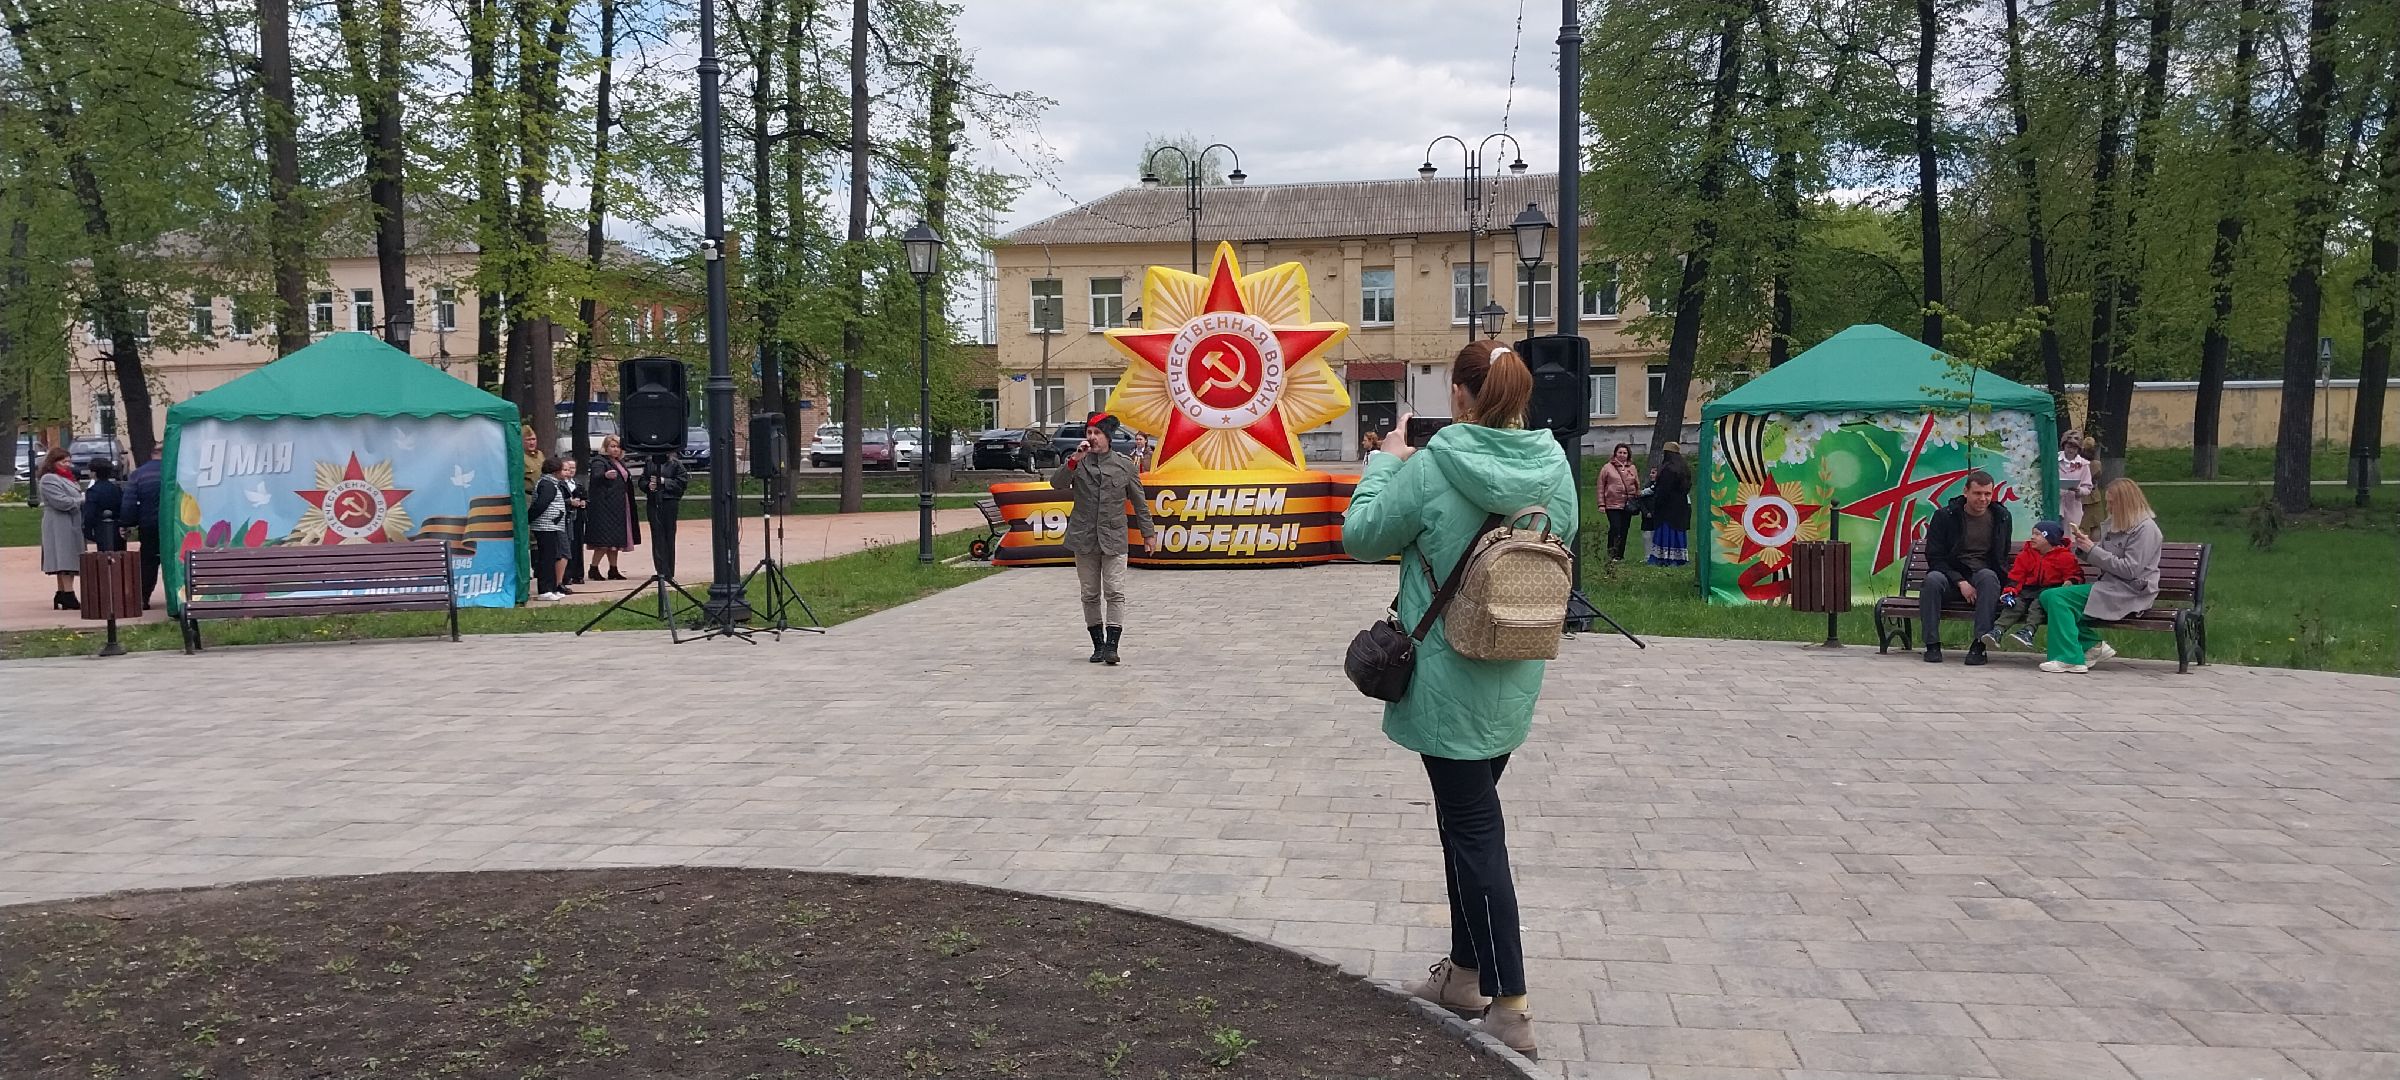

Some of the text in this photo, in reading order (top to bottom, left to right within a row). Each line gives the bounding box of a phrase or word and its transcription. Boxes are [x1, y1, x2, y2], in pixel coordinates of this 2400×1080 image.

[1172, 316, 1279, 418] ОТЕЧЕСТВЕННАЯ ВОЙНА
[197, 439, 294, 487] 9 МАЯ
[325, 482, 379, 532] ОТЕЧЕСТВЕННАЯ
[1025, 508, 1068, 540] 19
[1155, 488, 1287, 522] С ДНЕМ
